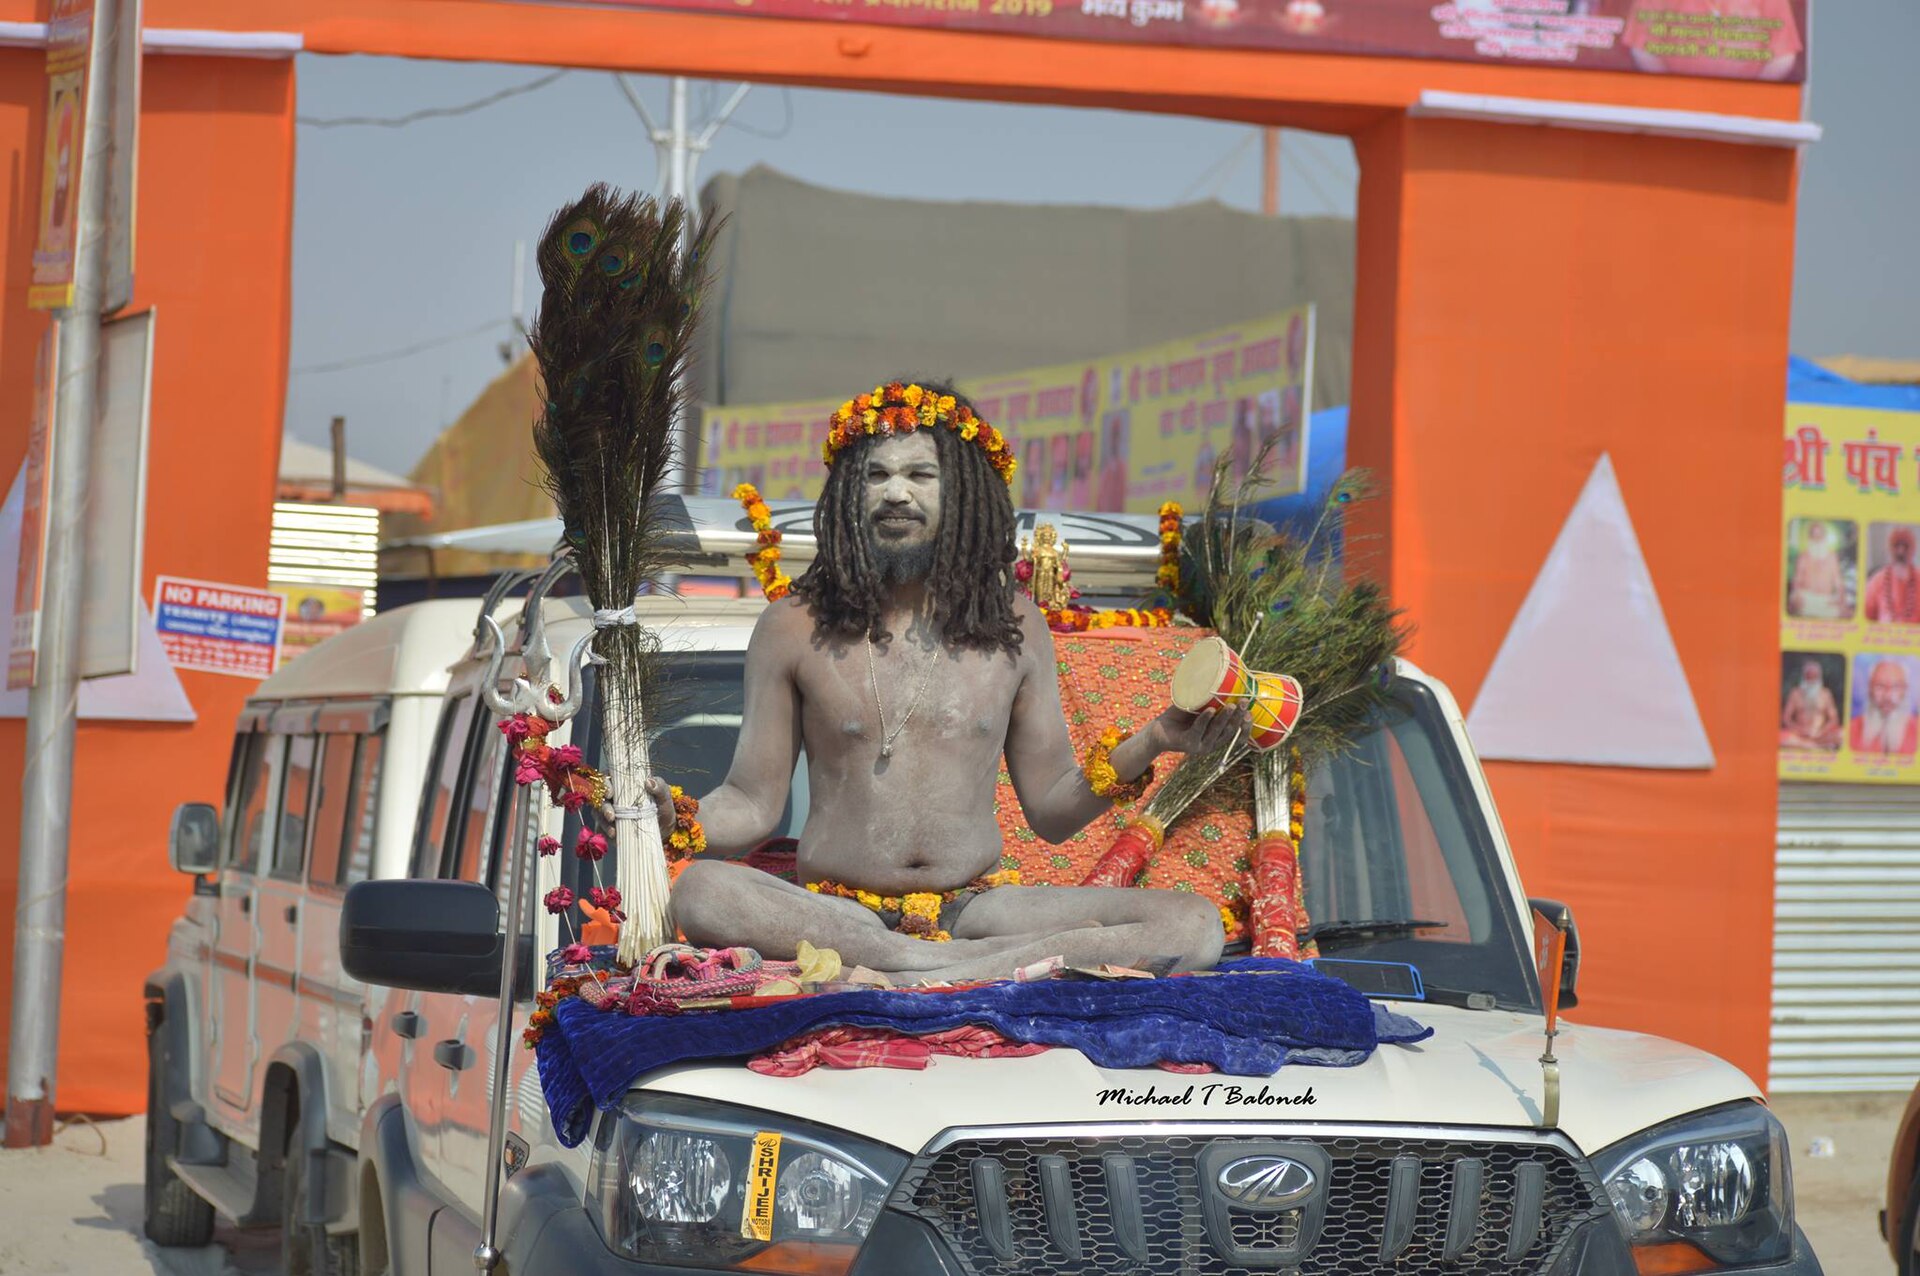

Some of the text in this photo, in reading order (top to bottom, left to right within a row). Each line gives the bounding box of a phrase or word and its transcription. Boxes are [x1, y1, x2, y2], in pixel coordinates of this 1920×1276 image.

[1841, 426, 1902, 494] पंच
[165, 585, 279, 615] NO PARKING
[755, 1147, 774, 1218] SHRIJEE
